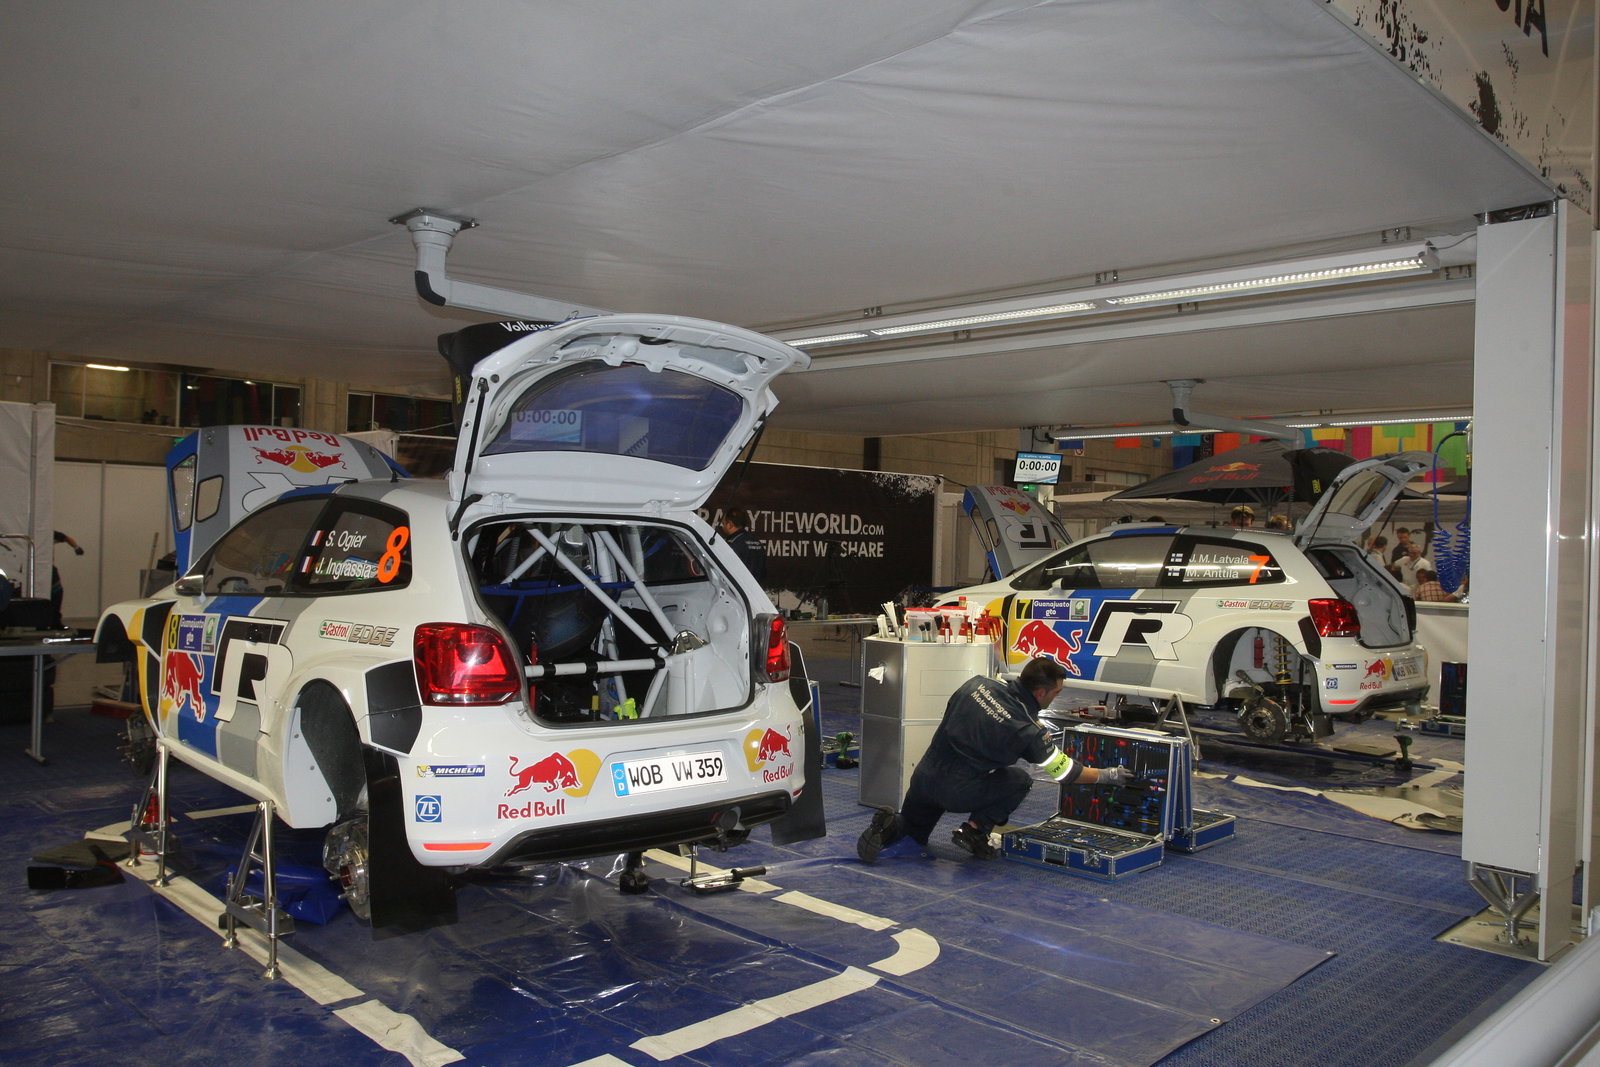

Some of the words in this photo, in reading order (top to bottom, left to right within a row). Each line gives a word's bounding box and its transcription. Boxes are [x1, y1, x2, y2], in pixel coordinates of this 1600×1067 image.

[243, 427, 292, 442] Bull
[291, 430, 340, 447] Red
[1019, 460, 1057, 472] 0:00:00
[325, 530, 336, 547] S.
[337, 530, 367, 552] Ogier
[376, 525, 410, 584] 8
[1213, 554, 1250, 565] Latvala
[315, 557, 325, 575] J.
[326, 557, 372, 580] Ingrassia
[1203, 569, 1239, 579] Anttila
[1248, 555, 1271, 584] 7
[1018, 599, 1032, 619] 7
[1223, 600, 1248, 608] Castrol
[1249, 600, 1295, 611] EDGE
[170, 614, 180, 650] 8
[326, 622, 350, 638] Castrol
[348, 623, 400, 647] EDGE
[1085, 600, 1194, 661] R
[970, 691, 1005, 724] Motorsport
[977, 684, 1012, 719] Volkswagen
[436, 766, 484, 775] MICHELIN
[628, 764, 663, 788] WOB
[762, 769, 780, 784] Red
[779, 762, 795, 780] Bull
[618, 783, 625, 791] D
[418, 800, 439, 818] ZF
[498, 801, 531, 820] Red
[534, 799, 565, 817] Bull
